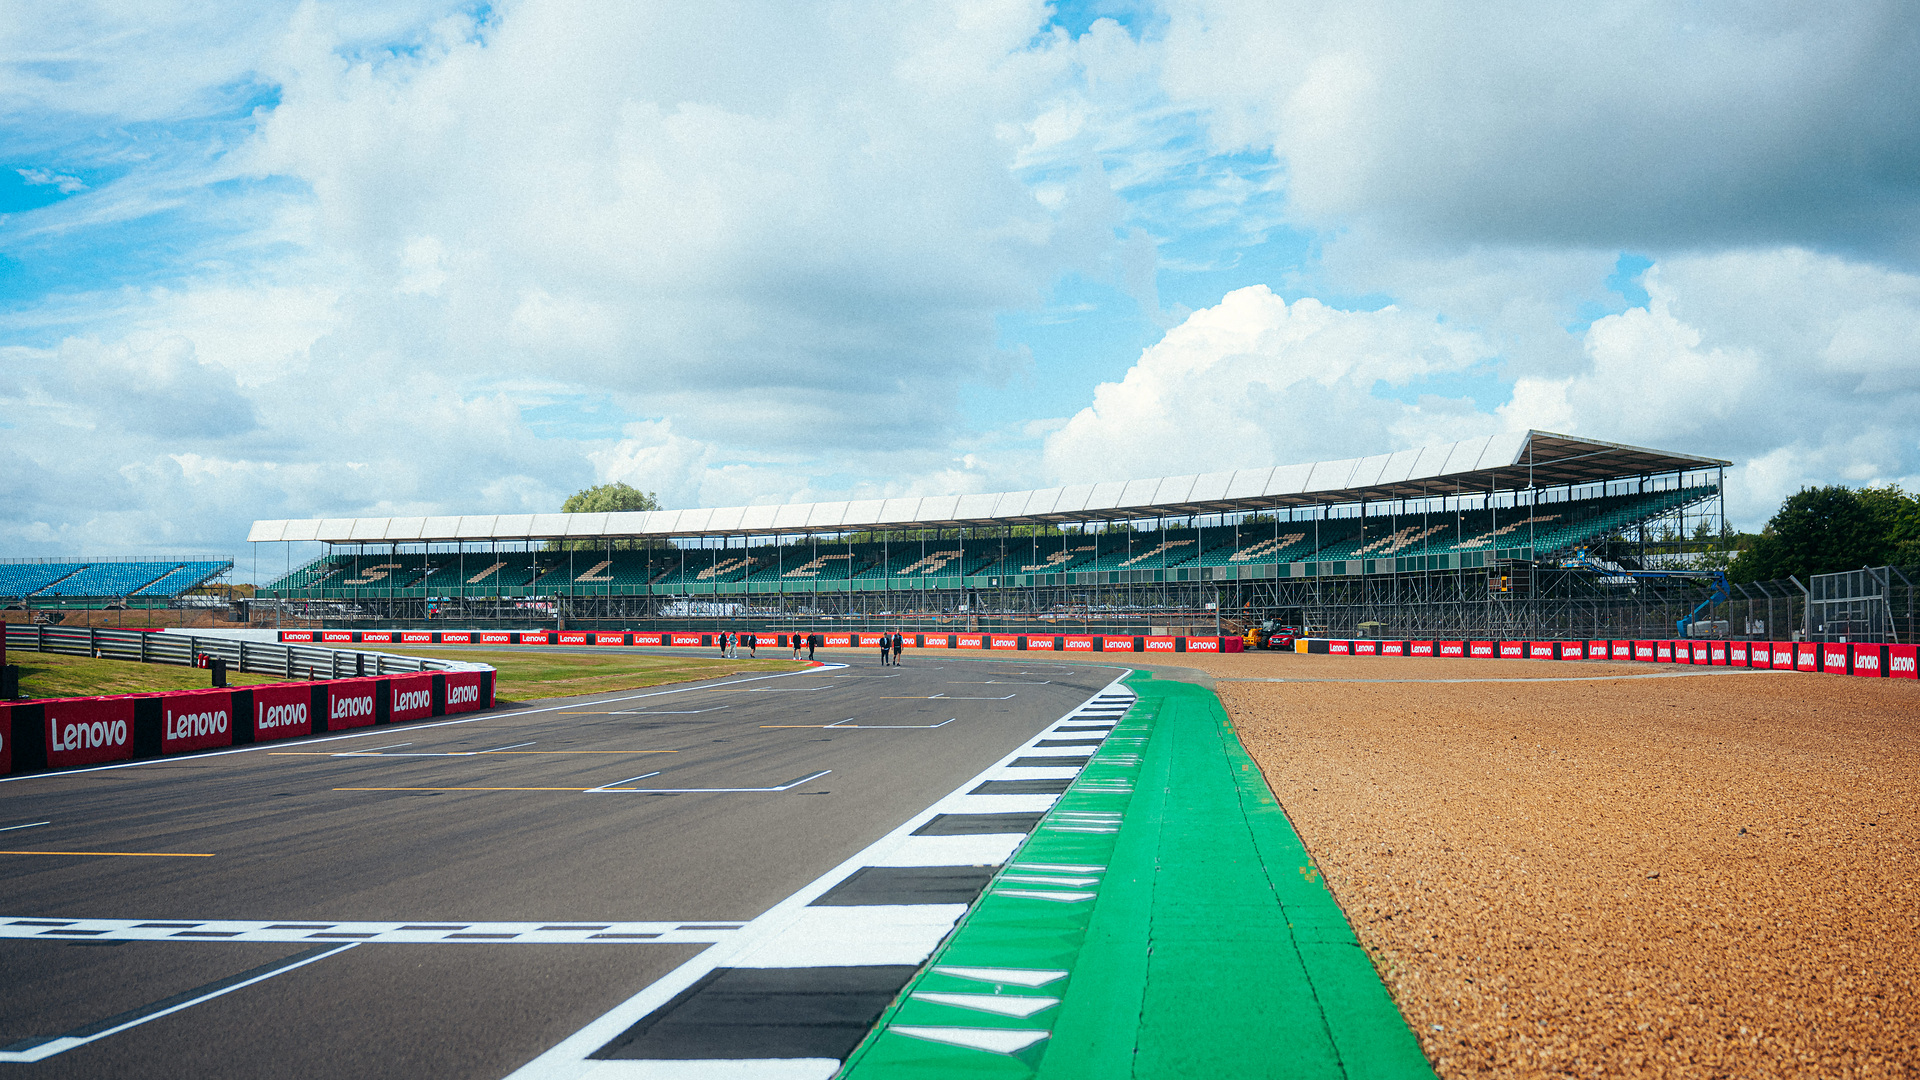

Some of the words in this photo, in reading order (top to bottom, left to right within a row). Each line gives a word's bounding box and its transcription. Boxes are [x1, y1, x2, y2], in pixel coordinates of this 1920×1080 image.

[324, 633, 351, 641] Lenovo
[363, 633, 390, 641] Lenovo
[443, 634, 469, 642] Lenovo
[559, 635, 585, 643] Lenovo
[634, 636, 660, 644] Lenovo
[673, 636, 699, 644] Lenovo
[755, 636, 776, 645] enovo
[825, 636, 849, 645] Lenovo
[860, 636, 881, 645] Lenov
[925, 636, 947, 646] Lenovo
[957, 637, 981, 646] Lenovo
[991, 637, 1017, 647] Lenovo
[1027, 638, 1053, 648] Lenovo
[1065, 639, 1091, 648] Lenovo
[1104, 639, 1132, 649] Lenovo
[1145, 640, 1173, 649] Lenovo
[1188, 640, 1217, 650] Lenovo
[1329, 643, 1347, 652] Lenovo
[1355, 643, 1375, 653] Lenovo
[1382, 644, 1402, 653] Lenovo
[1411, 644, 1431, 654] Lenovo
[1440, 645, 1461, 655] Lenovo
[1470, 645, 1492, 655] Lenovo
[1500, 645, 1521, 656] Lenovo
[1530, 646, 1552, 656] Lenovo
[1562, 646, 1581, 657] Lenovo
[1589, 645, 1606, 656] Lenovo
[1613, 645, 1629, 656] Lenovo
[1636, 645, 1653, 657] Lenovo
[1731, 647, 1747, 661] Lenovo
[1752, 647, 1769, 662] Lenovo
[1773, 649, 1792, 665] Lenovo
[1798, 650, 1815, 667] Lenovo
[1824, 650, 1846, 668] Lenovo
[1854, 652, 1879, 670] Lenovo
[1890, 652, 1915, 672] Lenovo
[447, 683, 478, 704] Lenovo
[394, 688, 430, 712] Lenovo
[331, 694, 373, 719] Lenovo
[259, 701, 308, 729] Lenovo
[166, 709, 228, 740] Lenovo
[51, 718, 127, 752] Lenovo
